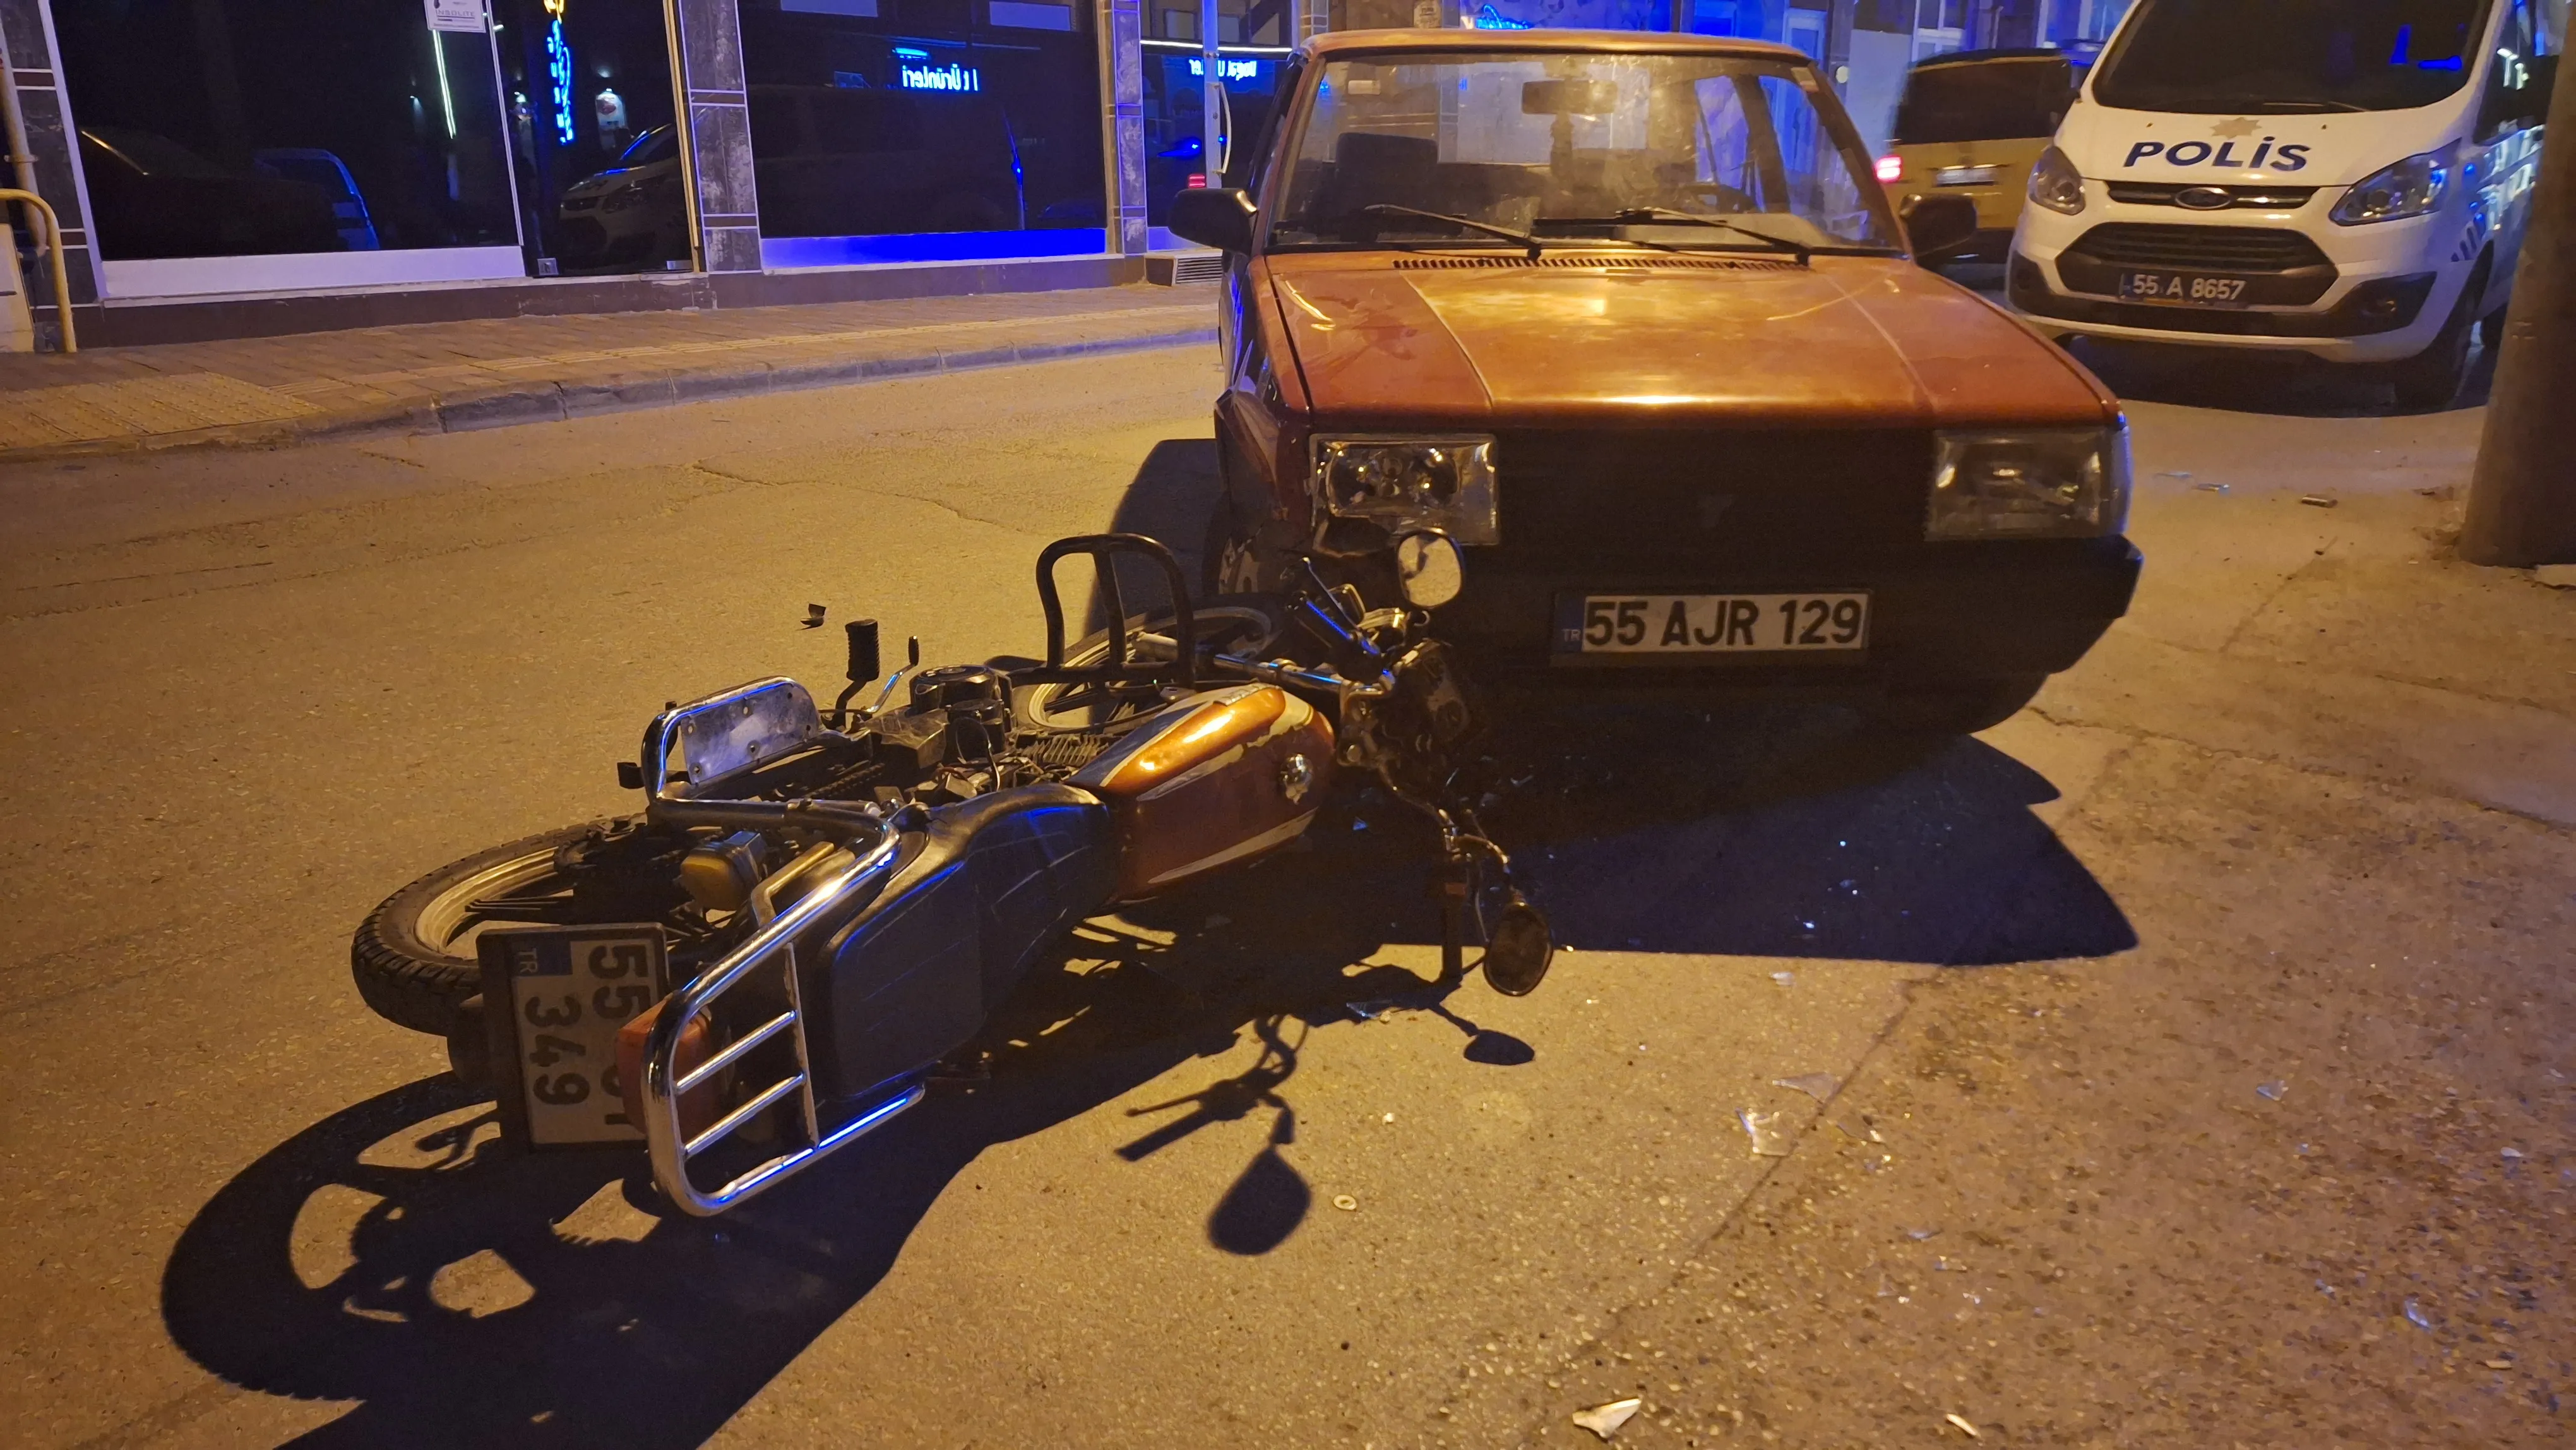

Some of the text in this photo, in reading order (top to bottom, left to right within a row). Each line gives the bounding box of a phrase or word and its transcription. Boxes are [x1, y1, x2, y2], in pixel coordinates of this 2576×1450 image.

[2123, 136, 2311, 171] POLİS
[2133, 274, 2246, 301] 55 A 8657
[1561, 599, 1861, 646] TR 55 AJR 129
[515, 947, 538, 974] TR
[588, 944, 651, 1020] 55
[525, 995, 590, 1105] 349
